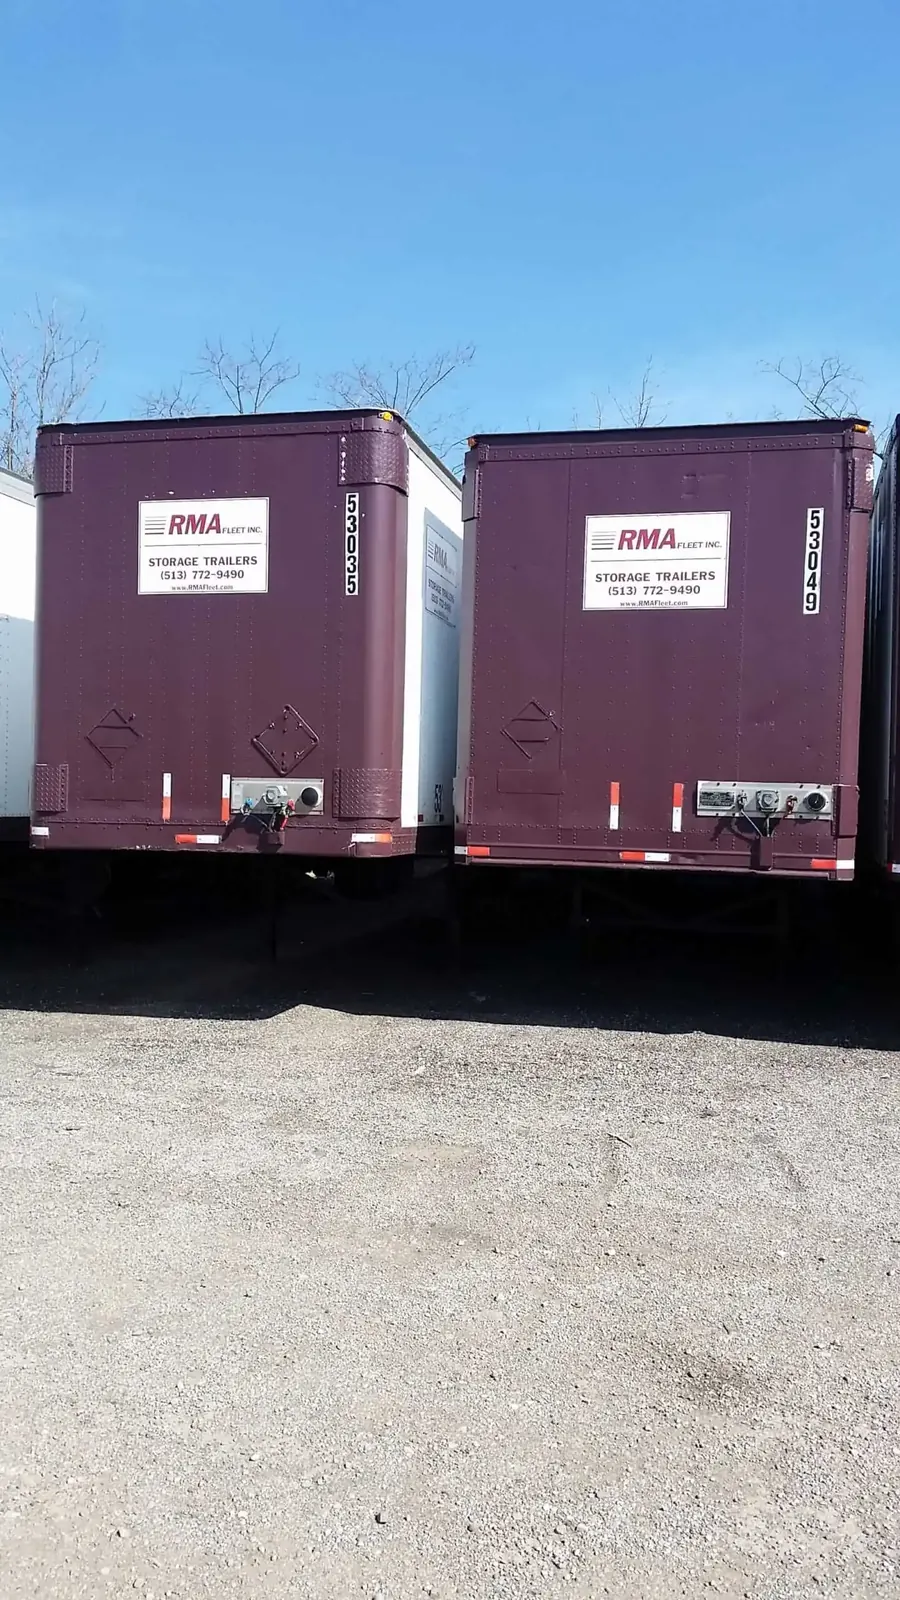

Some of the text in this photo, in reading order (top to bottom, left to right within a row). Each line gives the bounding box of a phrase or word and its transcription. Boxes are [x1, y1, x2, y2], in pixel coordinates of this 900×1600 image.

[168, 513, 222, 535] RMA
[346, 494, 357, 594] 53035
[618, 528, 723, 550] RMA FLEET INC.
[148, 556, 258, 567] STORAGE TRAILERS
[805, 509, 820, 611] 53049
[160, 570, 245, 581] (513) 772-9490
[595, 571, 716, 583] STORAGE TRAILERS
[608, 585, 701, 596] (513) 772-9490
[620, 599, 688, 607] www.RMAFleet.com
